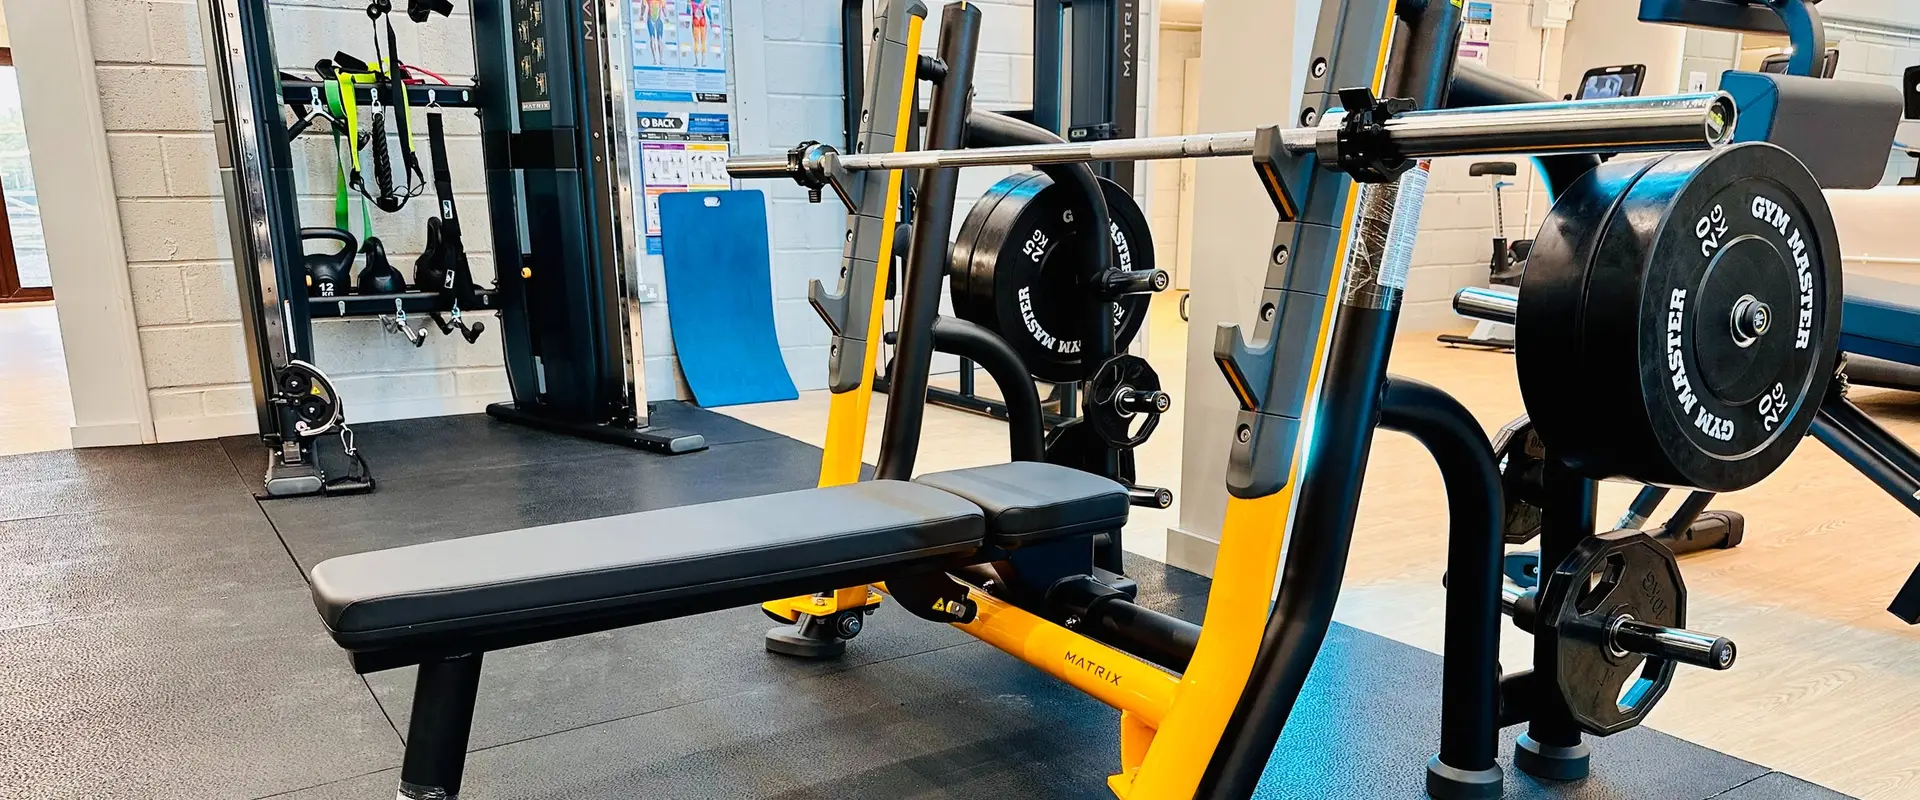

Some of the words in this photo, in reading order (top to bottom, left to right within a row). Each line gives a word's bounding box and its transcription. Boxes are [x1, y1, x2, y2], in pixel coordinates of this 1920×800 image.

[1123, 3, 1133, 77] MATRI
[651, 117, 676, 129] BACK
[1032, 229, 1050, 248] KG
[1695, 216, 1719, 258] 20
[1710, 203, 1729, 239] KG
[1022, 241, 1045, 263] 25
[1108, 218, 1132, 273] ASTER
[318, 282, 334, 292] 12
[1750, 195, 1793, 237] GYM
[1786, 229, 1814, 350] MASTER
[1018, 286, 1057, 350] MASTER
[1058, 340, 1082, 354] YM
[1666, 287, 1701, 417] MASTER
[1757, 393, 1779, 433] 20
[1771, 380, 1789, 415] KG
[1693, 406, 1735, 443] GYM
[1064, 650, 1123, 687] MATRIX
